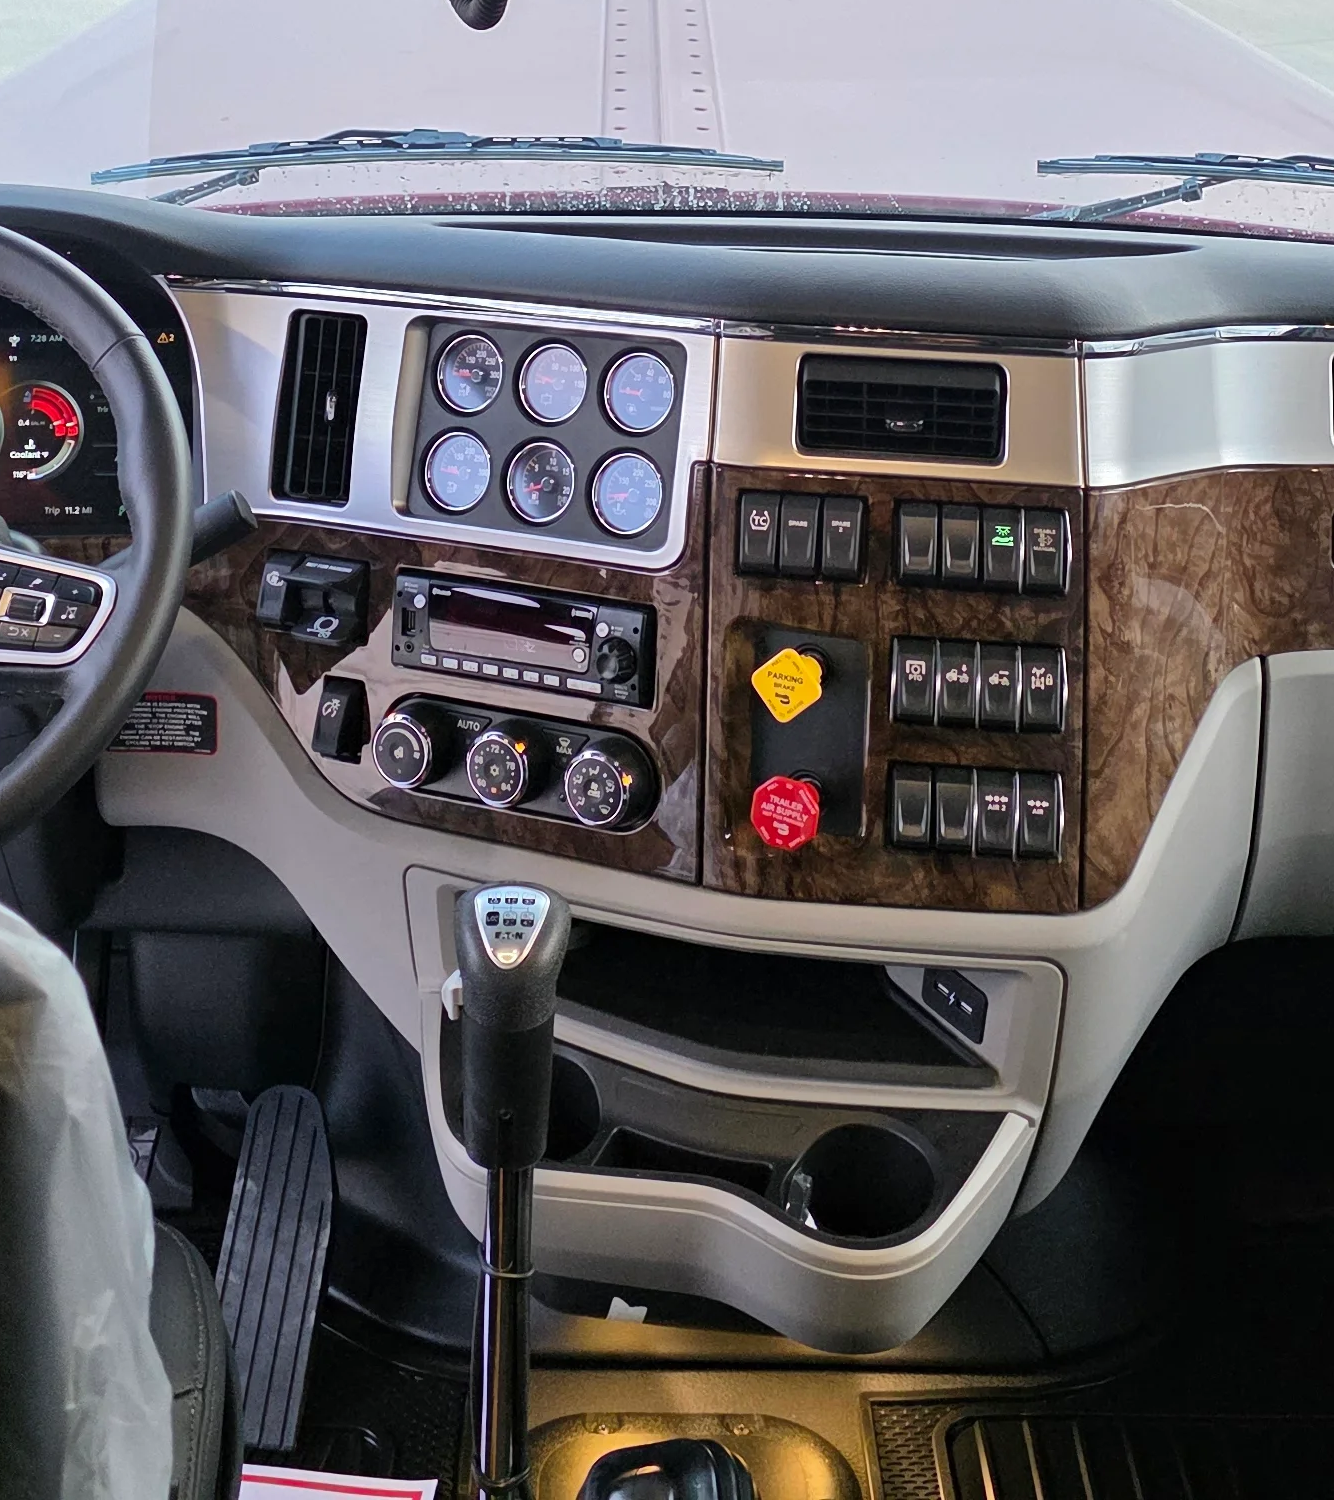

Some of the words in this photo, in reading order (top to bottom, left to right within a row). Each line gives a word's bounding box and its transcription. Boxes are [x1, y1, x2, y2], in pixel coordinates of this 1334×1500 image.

[169, 334, 175, 342] 2
[9, 451, 41, 459] Coolant
[45, 507, 60, 516] Trip
[753, 516, 767, 526] TC
[767, 670, 803, 684] PARKING
[909, 674, 923, 682] PTO
[773, 682, 795, 692] BRAKE
[457, 720, 481, 732] AUTO
[491, 744, 500, 754] 72
[556, 744, 573, 756] MAX
[769, 794, 803, 812] TRAILER
[761, 802, 775, 812] AIR
[776, 806, 809, 822] SUPPLY
[495, 932, 524, 940] EATON
